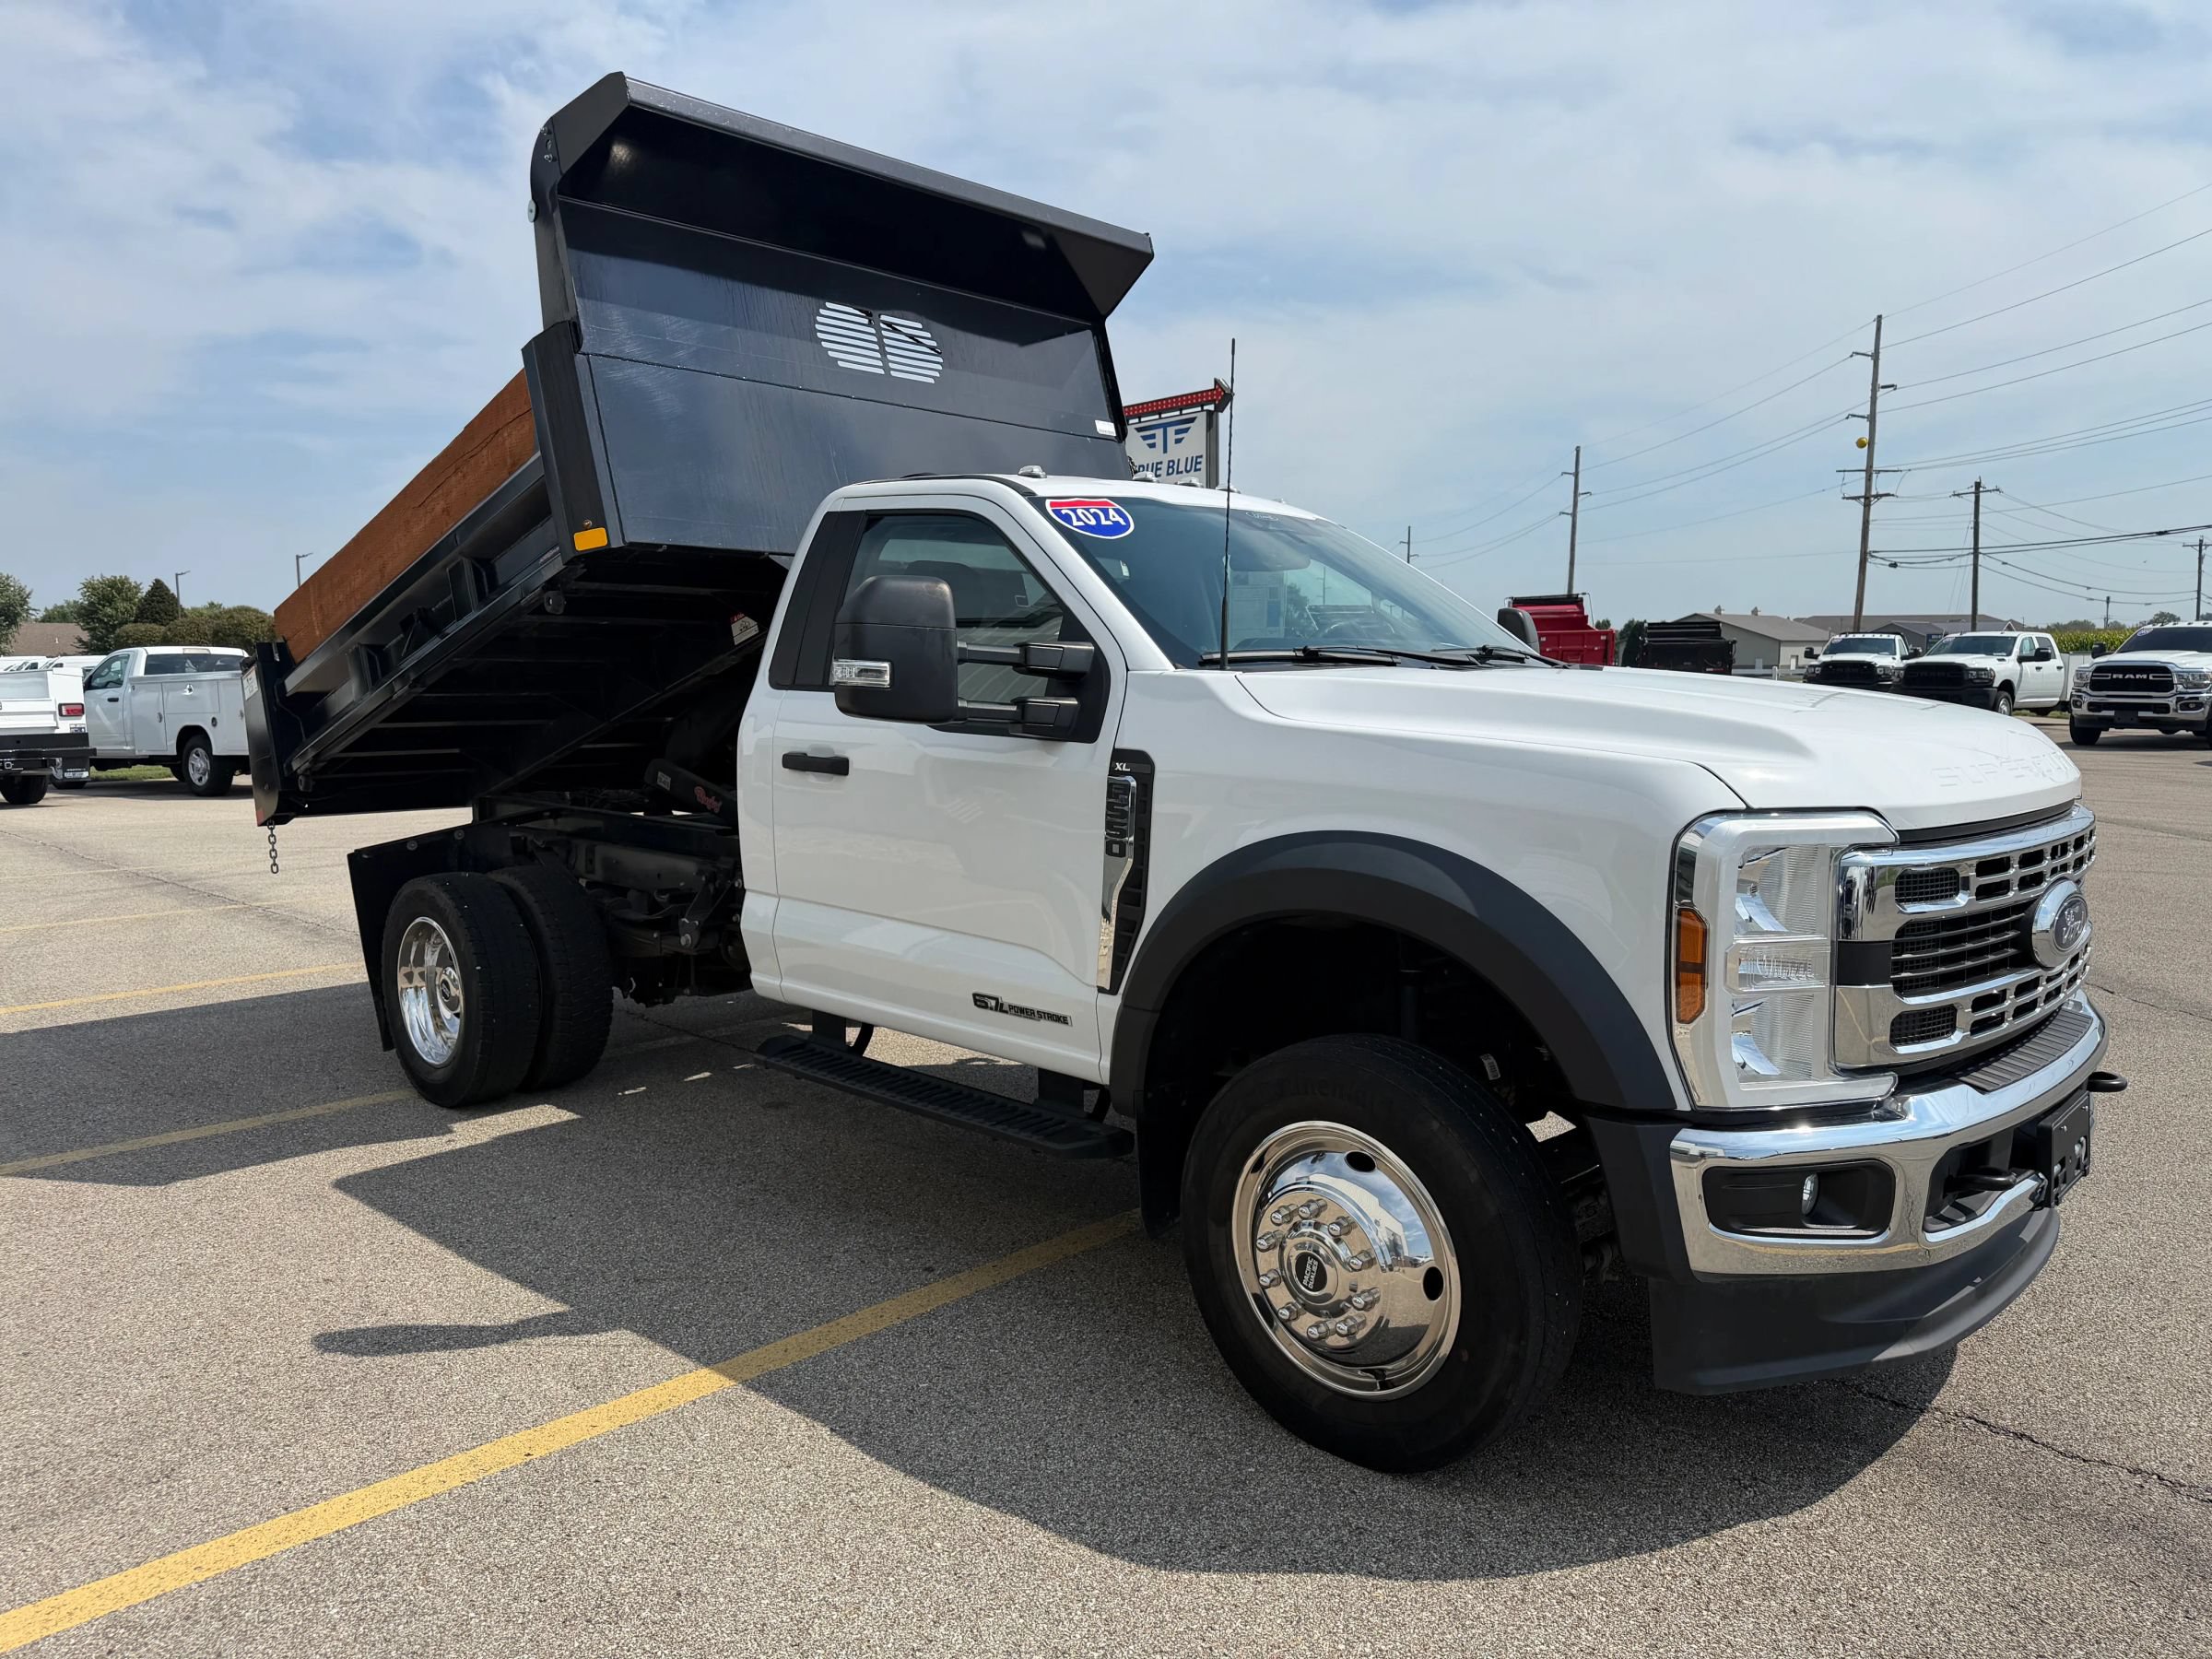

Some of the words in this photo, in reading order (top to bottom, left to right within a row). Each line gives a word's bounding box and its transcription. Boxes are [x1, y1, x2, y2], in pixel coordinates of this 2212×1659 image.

[1166, 454, 1204, 477] BLUE
[1061, 508, 1126, 526] 2024
[1114, 762, 1131, 771] XL
[972, 993, 1009, 1015] 6.7L
[1008, 1004, 1036, 1018] POWER
[1036, 1010, 1069, 1025] STROKE
[1302, 1256, 1314, 1287] PACIFIC
